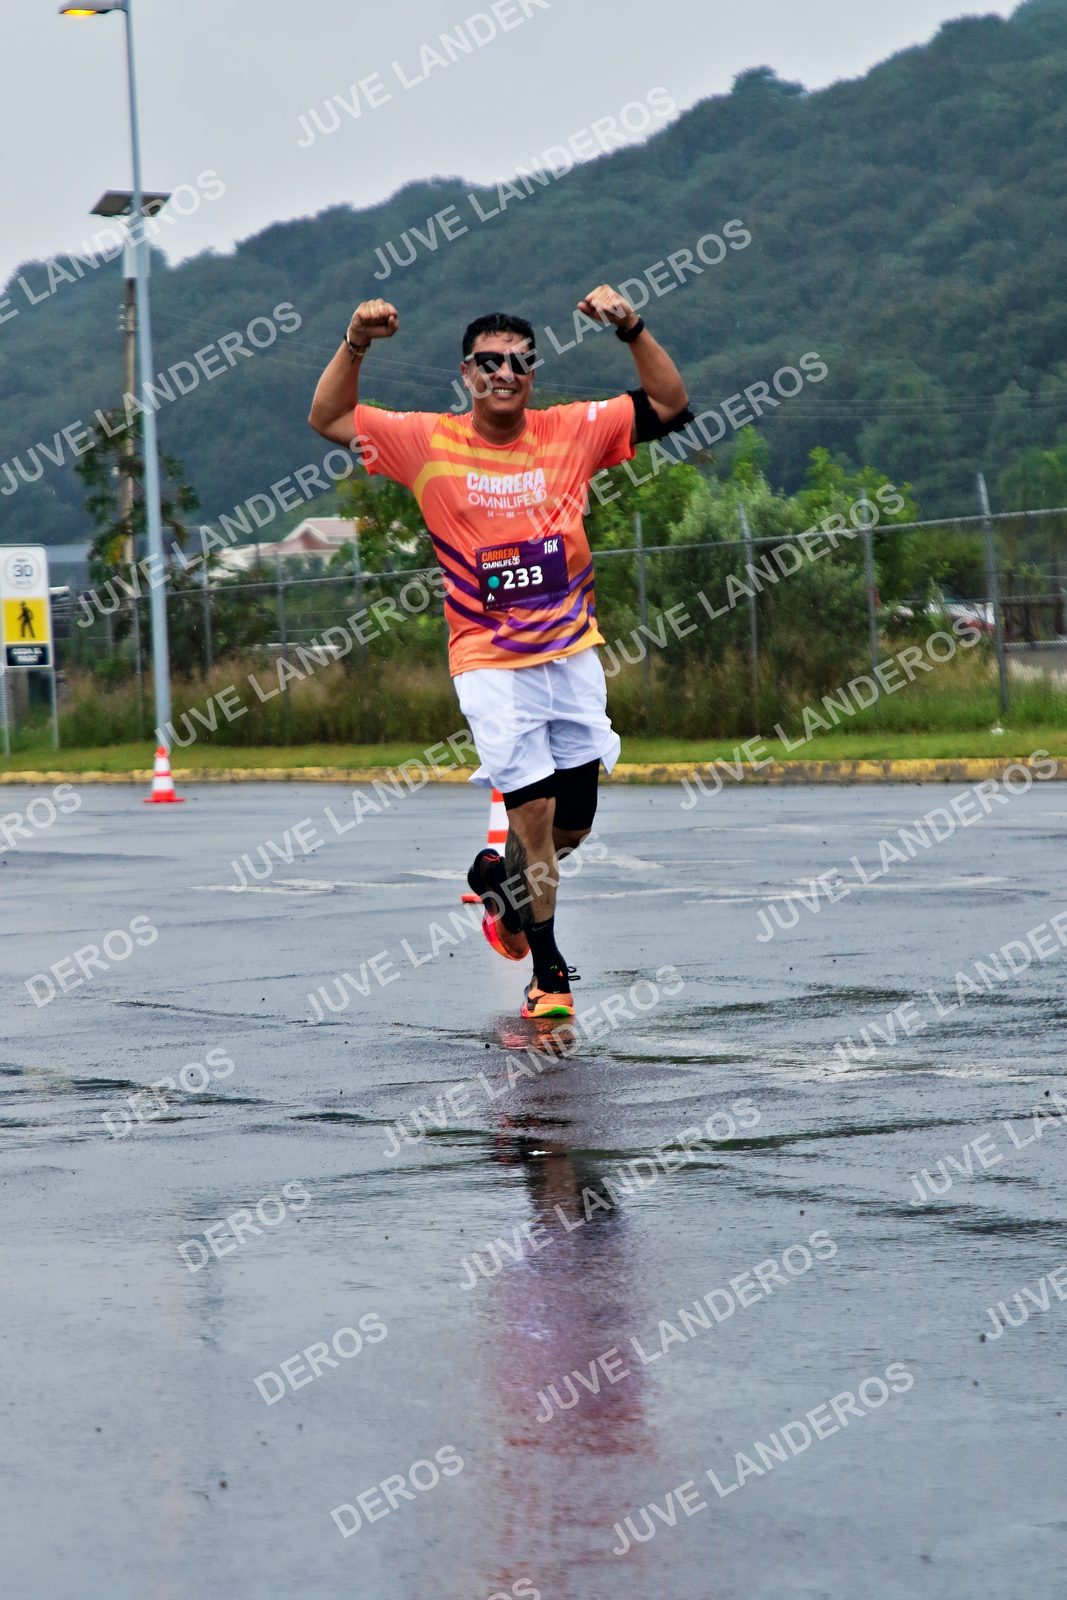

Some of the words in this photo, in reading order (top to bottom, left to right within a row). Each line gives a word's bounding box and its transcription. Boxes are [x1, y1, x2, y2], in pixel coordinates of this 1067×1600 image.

[467, 468, 545, 495] CARRERA
[468, 492, 532, 509] OMNILIFE
[481, 547, 520, 562] CARRERA
[543, 539, 559, 554] 16K
[12, 565, 33, 578] 30
[501, 565, 543, 589] 233
